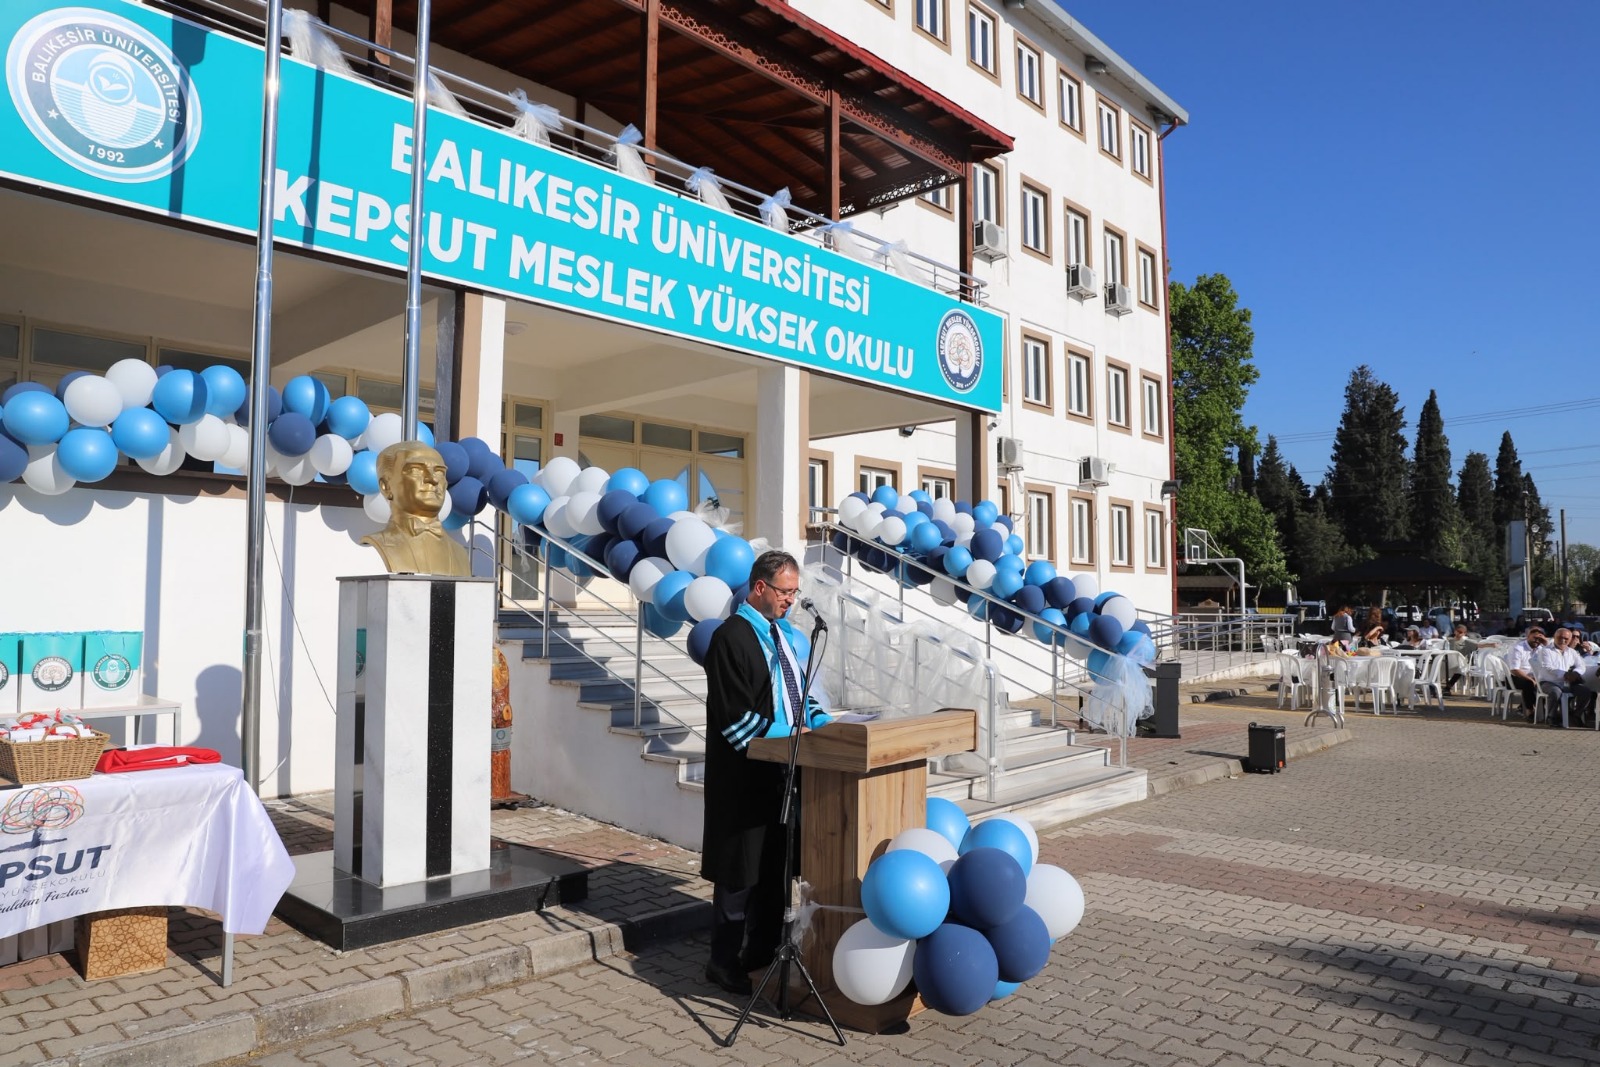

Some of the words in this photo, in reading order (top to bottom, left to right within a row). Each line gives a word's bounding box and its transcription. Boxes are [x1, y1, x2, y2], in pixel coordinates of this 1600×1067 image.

[32, 27, 97, 84] BALIKESİR
[102, 29, 183, 125] ÜNİVERSİTESİ
[88, 144, 125, 162] 1992
[391, 122, 641, 246] BALIKESİR
[651, 203, 870, 316] ÜNİVERSİTESİ
[273, 168, 497, 271] KEPSUT
[508, 234, 678, 320] MESLEK
[687, 285, 819, 355] YÜKSEK
[825, 326, 914, 379] OKULU
[0, 845, 112, 888] PSUT
